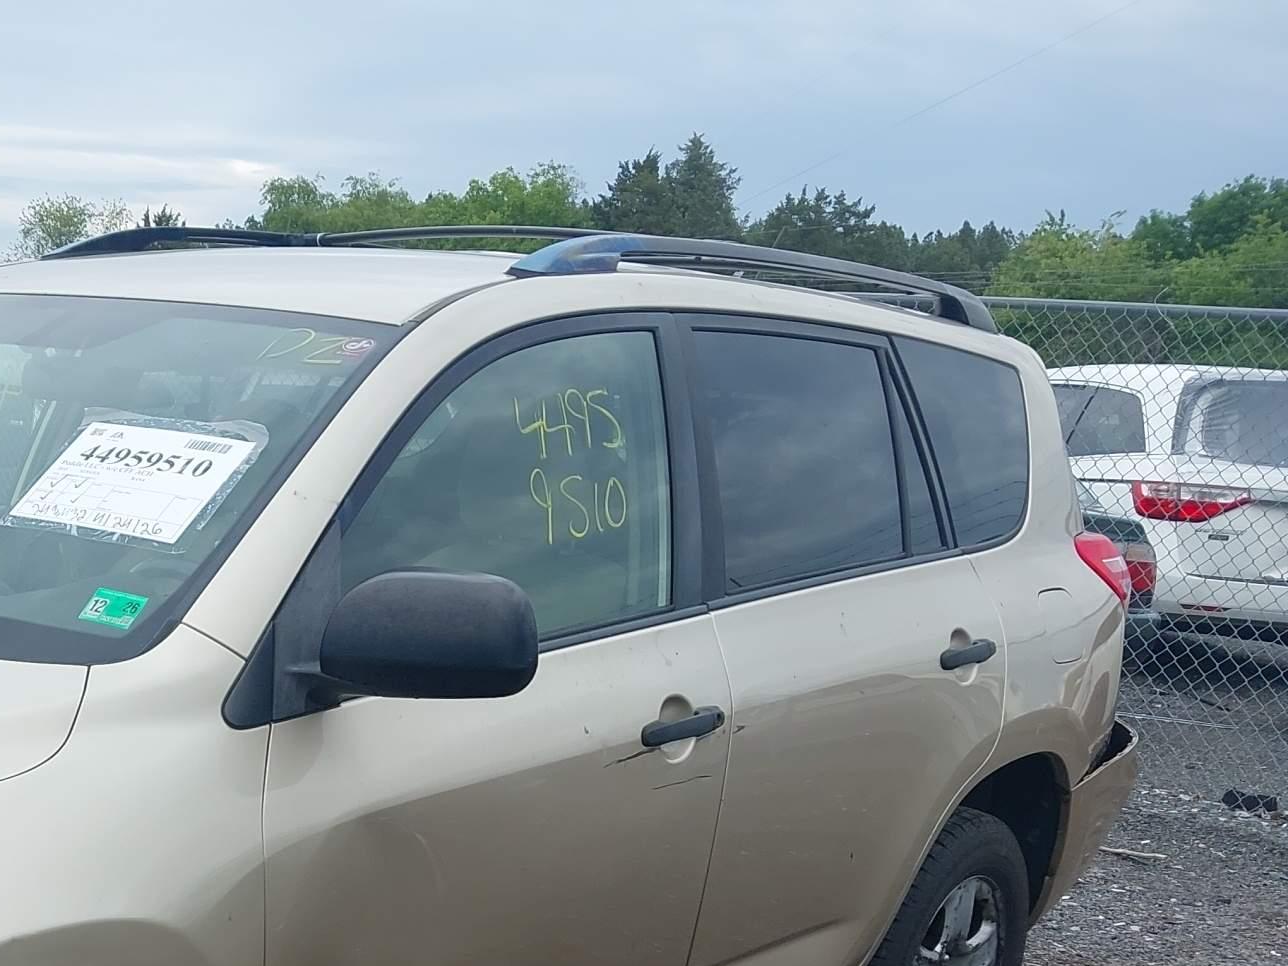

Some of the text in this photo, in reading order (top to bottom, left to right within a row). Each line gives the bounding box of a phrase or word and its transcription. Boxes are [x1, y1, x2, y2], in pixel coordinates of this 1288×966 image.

[514, 387, 626, 459] 4495
[80, 444, 213, 477] 44959510
[530, 468, 627, 544] 9510
[90, 599, 141, 614] 12 26
